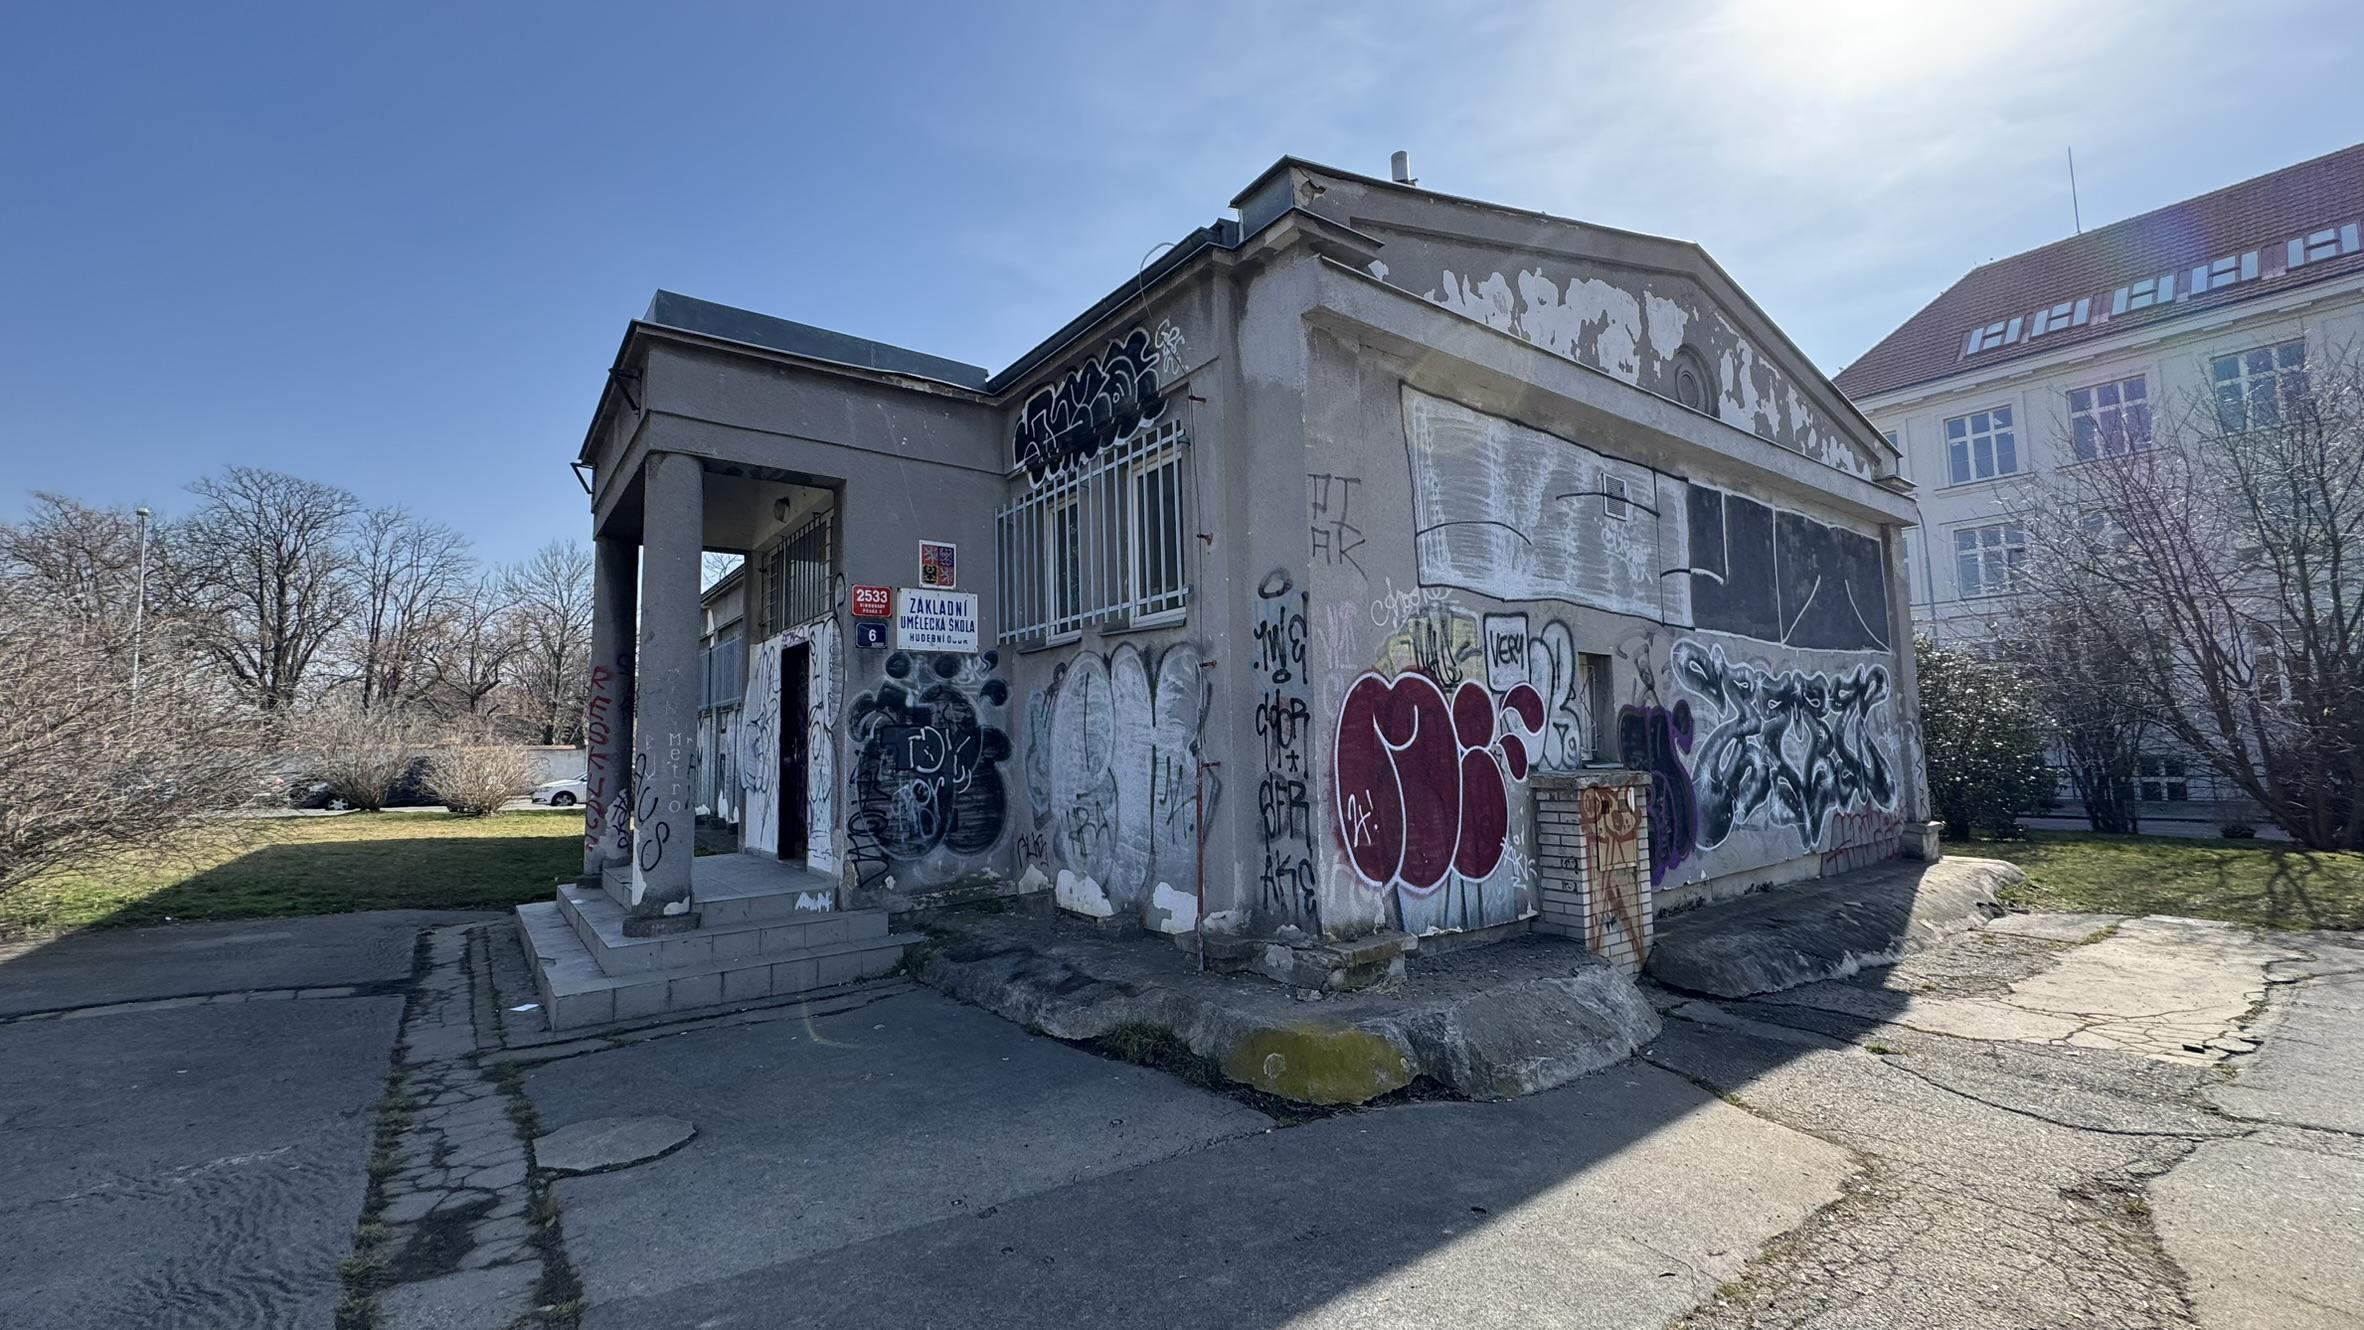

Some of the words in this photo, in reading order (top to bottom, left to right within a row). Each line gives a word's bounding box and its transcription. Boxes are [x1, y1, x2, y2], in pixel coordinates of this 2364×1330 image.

[856, 589, 888, 603] 2533
[909, 596, 968, 617] ZÁKLADNÍ
[900, 615, 946, 632] UMĚLECKÁ
[948, 617, 975, 633] ŠKOLA
[868, 629, 877, 642] 6
[909, 633, 945, 643] HUDEBNÍ
[1490, 630, 1524, 670] VERY
